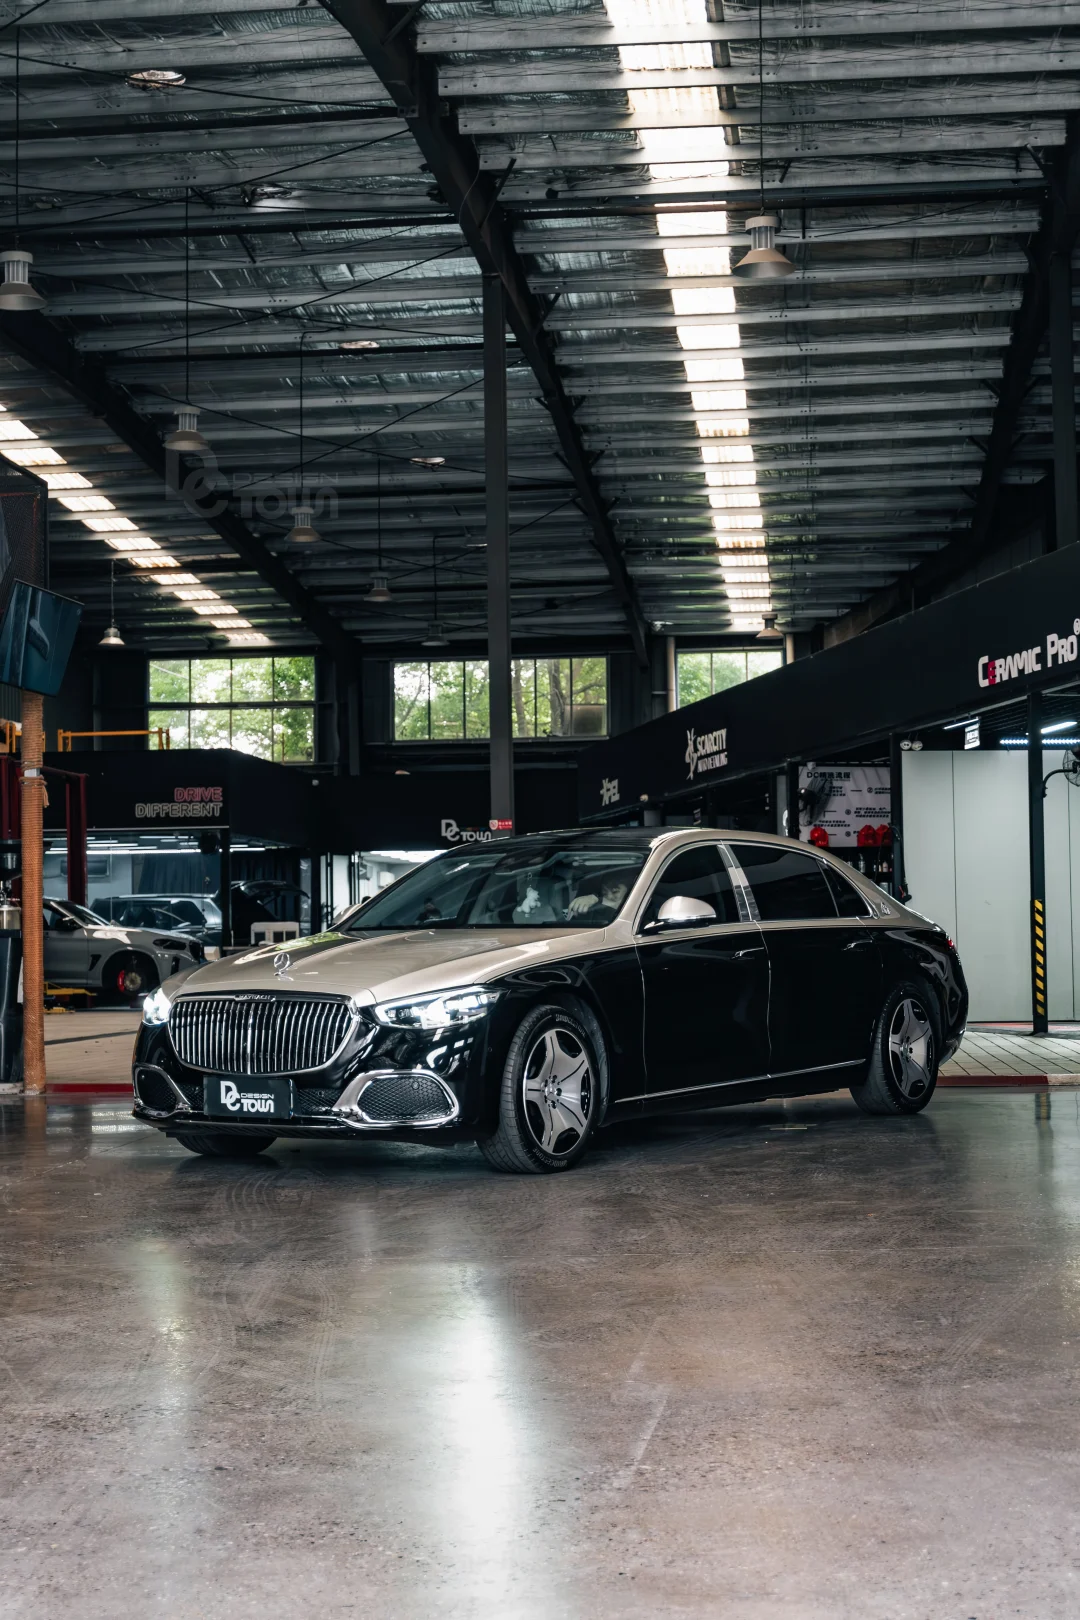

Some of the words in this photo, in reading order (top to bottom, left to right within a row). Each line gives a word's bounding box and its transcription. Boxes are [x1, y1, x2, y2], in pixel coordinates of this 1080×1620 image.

[978, 646, 1042, 688] CERAMIC
[697, 728, 727, 757] SCARCITY
[174, 787, 223, 802] DRIVE
[135, 803, 223, 818] DIFFERENT
[460, 831, 491, 841] TOWN
[240, 1099, 274, 1113] TOWN
